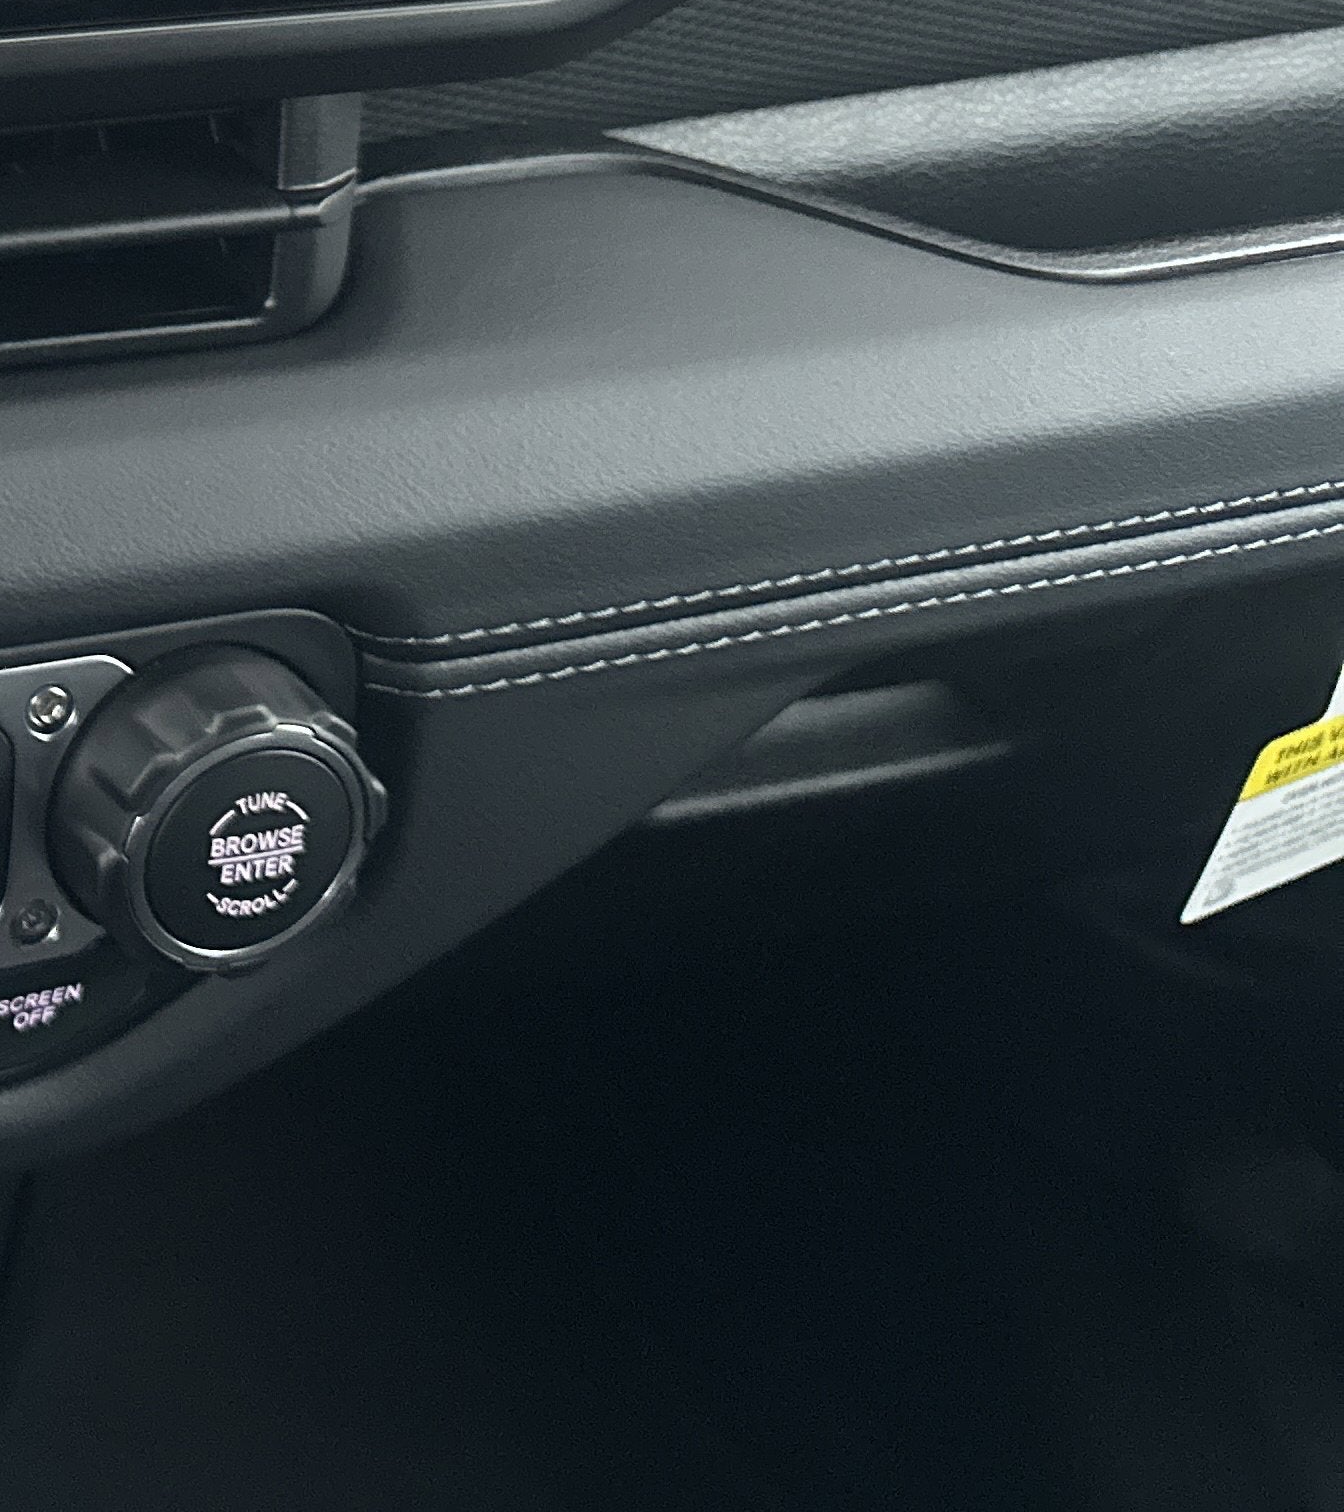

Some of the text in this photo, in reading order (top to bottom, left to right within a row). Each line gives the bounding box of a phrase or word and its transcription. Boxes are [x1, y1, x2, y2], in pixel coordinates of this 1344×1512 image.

[235, 792, 288, 815] TUNE
[210, 824, 305, 858] BROWSE
[220, 855, 294, 885] ENTER
[216, 888, 287, 916] SCROLL
[13, 1004, 58, 1031] OFF
